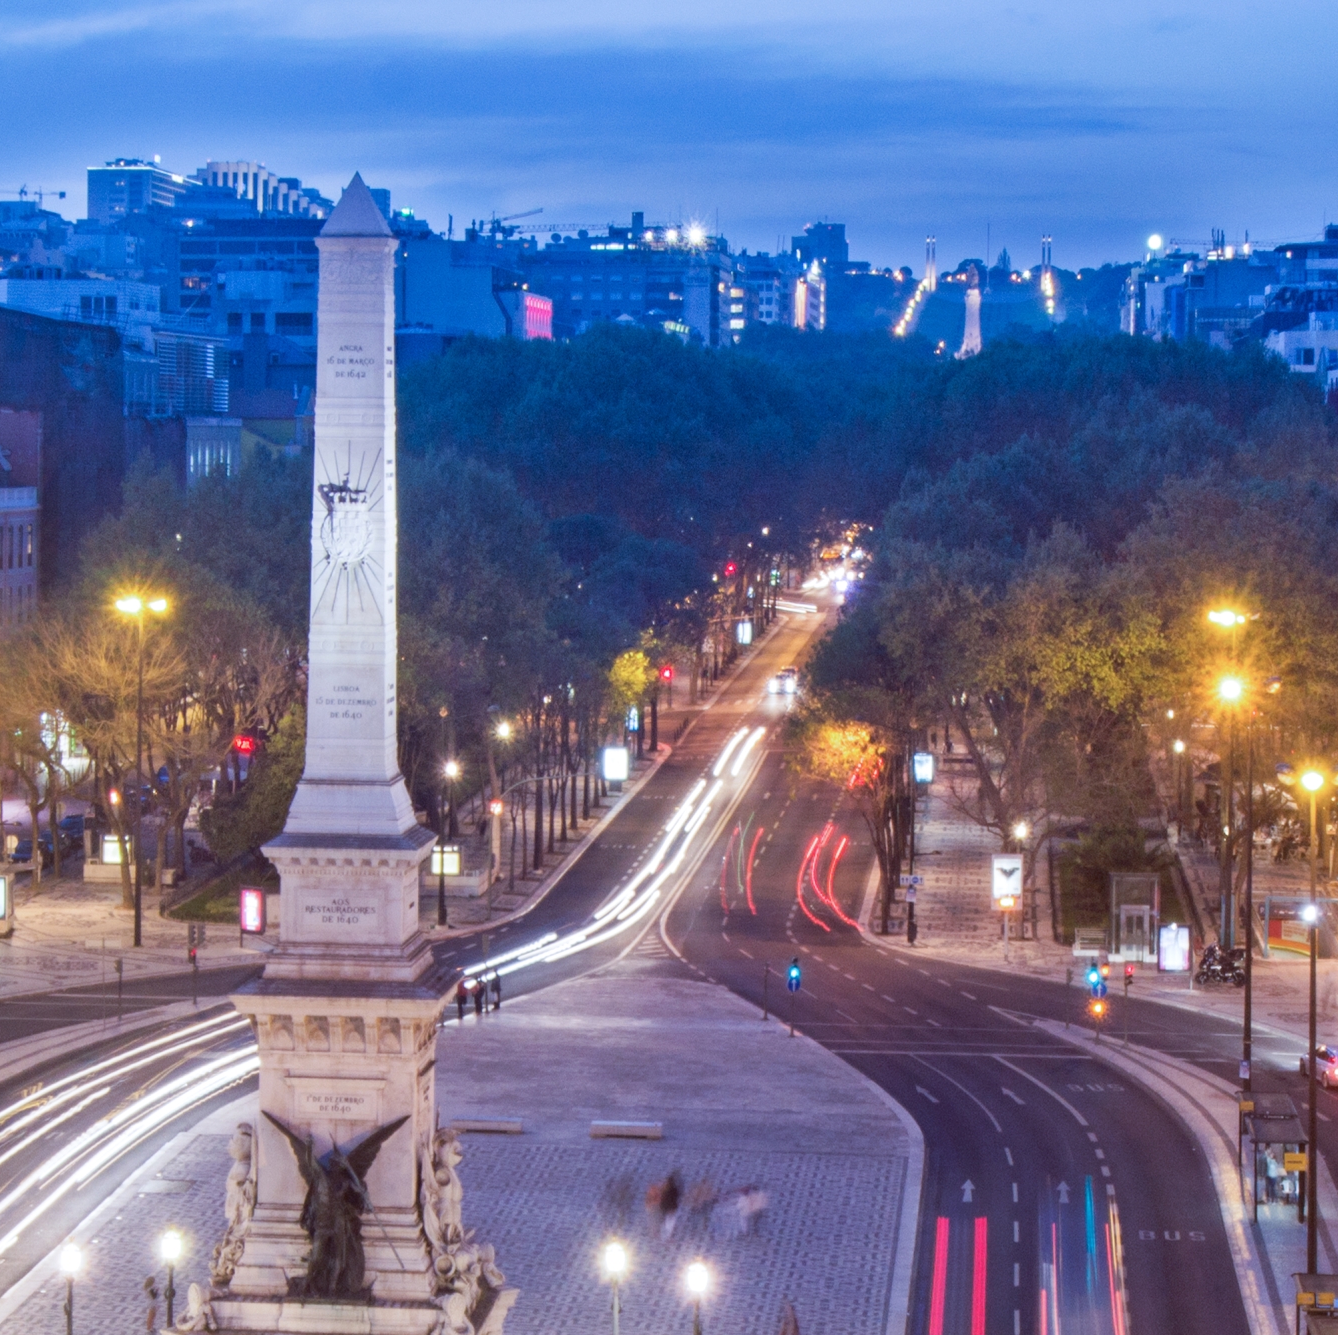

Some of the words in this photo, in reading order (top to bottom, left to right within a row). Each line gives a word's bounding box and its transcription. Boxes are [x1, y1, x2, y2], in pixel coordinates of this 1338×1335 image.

[337, 699, 377, 707] DEZEMBRO
[305, 905, 376, 915] RESTAURADORES
[337, 916, 359, 924] 1640
[1138, 1230, 1205, 1241] BUS
